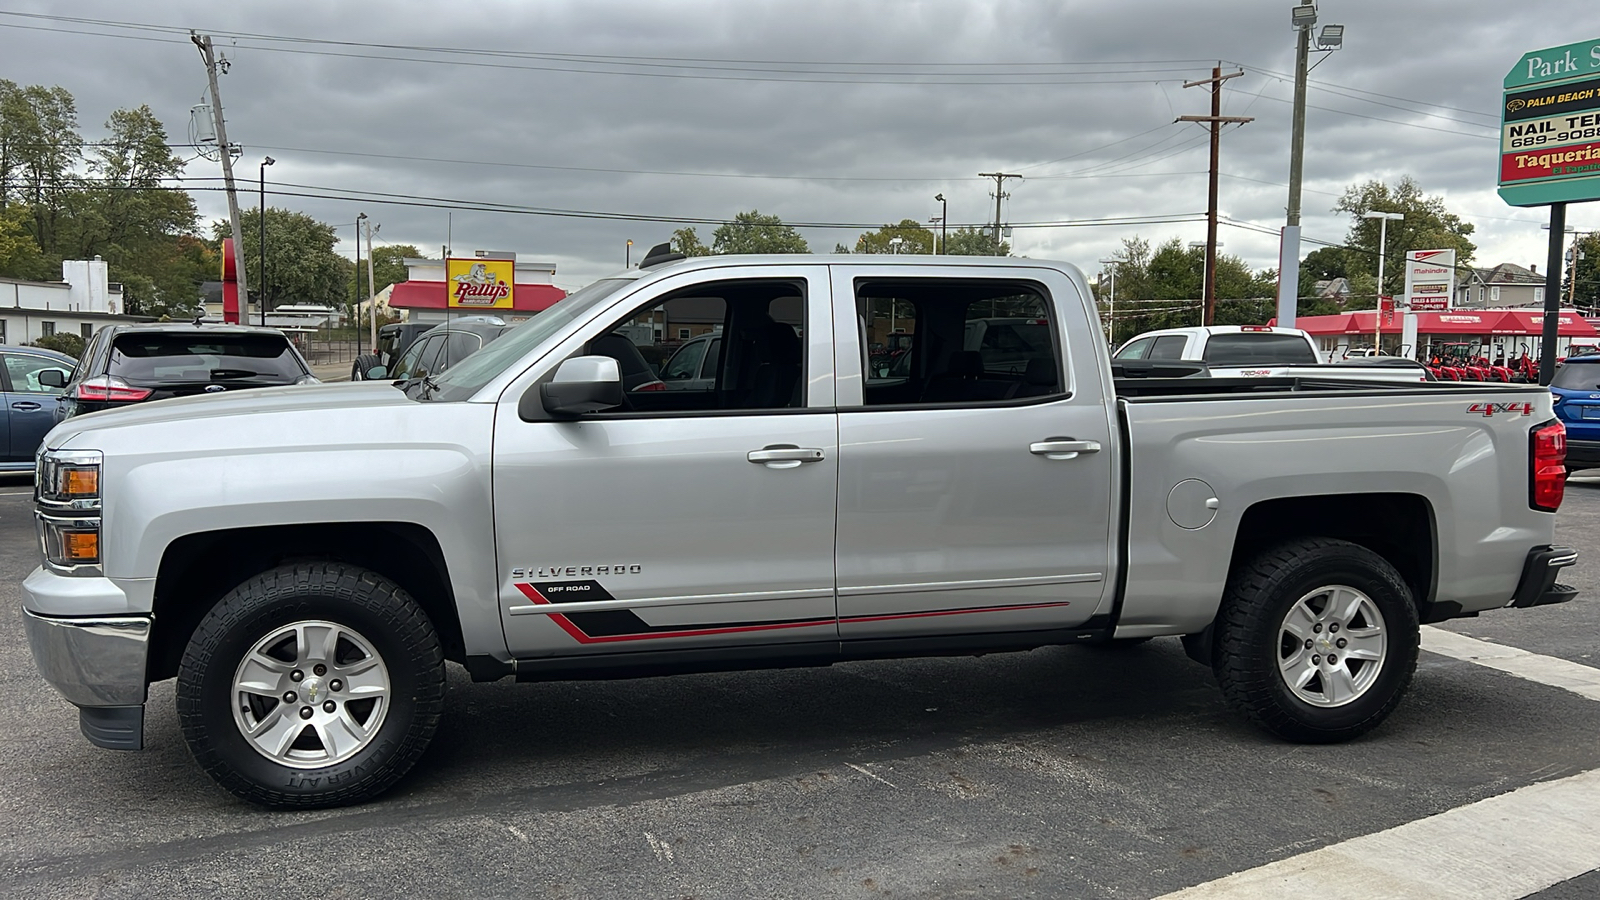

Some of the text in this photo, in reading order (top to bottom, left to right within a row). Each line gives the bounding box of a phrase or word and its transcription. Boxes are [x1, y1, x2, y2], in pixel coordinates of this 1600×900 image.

[1527, 50, 1578, 79] Park
[1526, 95, 1555, 108] PALM
[1557, 89, 1594, 103] BEACH
[1510, 121, 1556, 138] NAIL
[1511, 128, 1600, 148] 689-908
[1552, 166, 1563, 174] El
[454, 280, 509, 304] Rally's
[512, 564, 642, 579] SILVERADO
